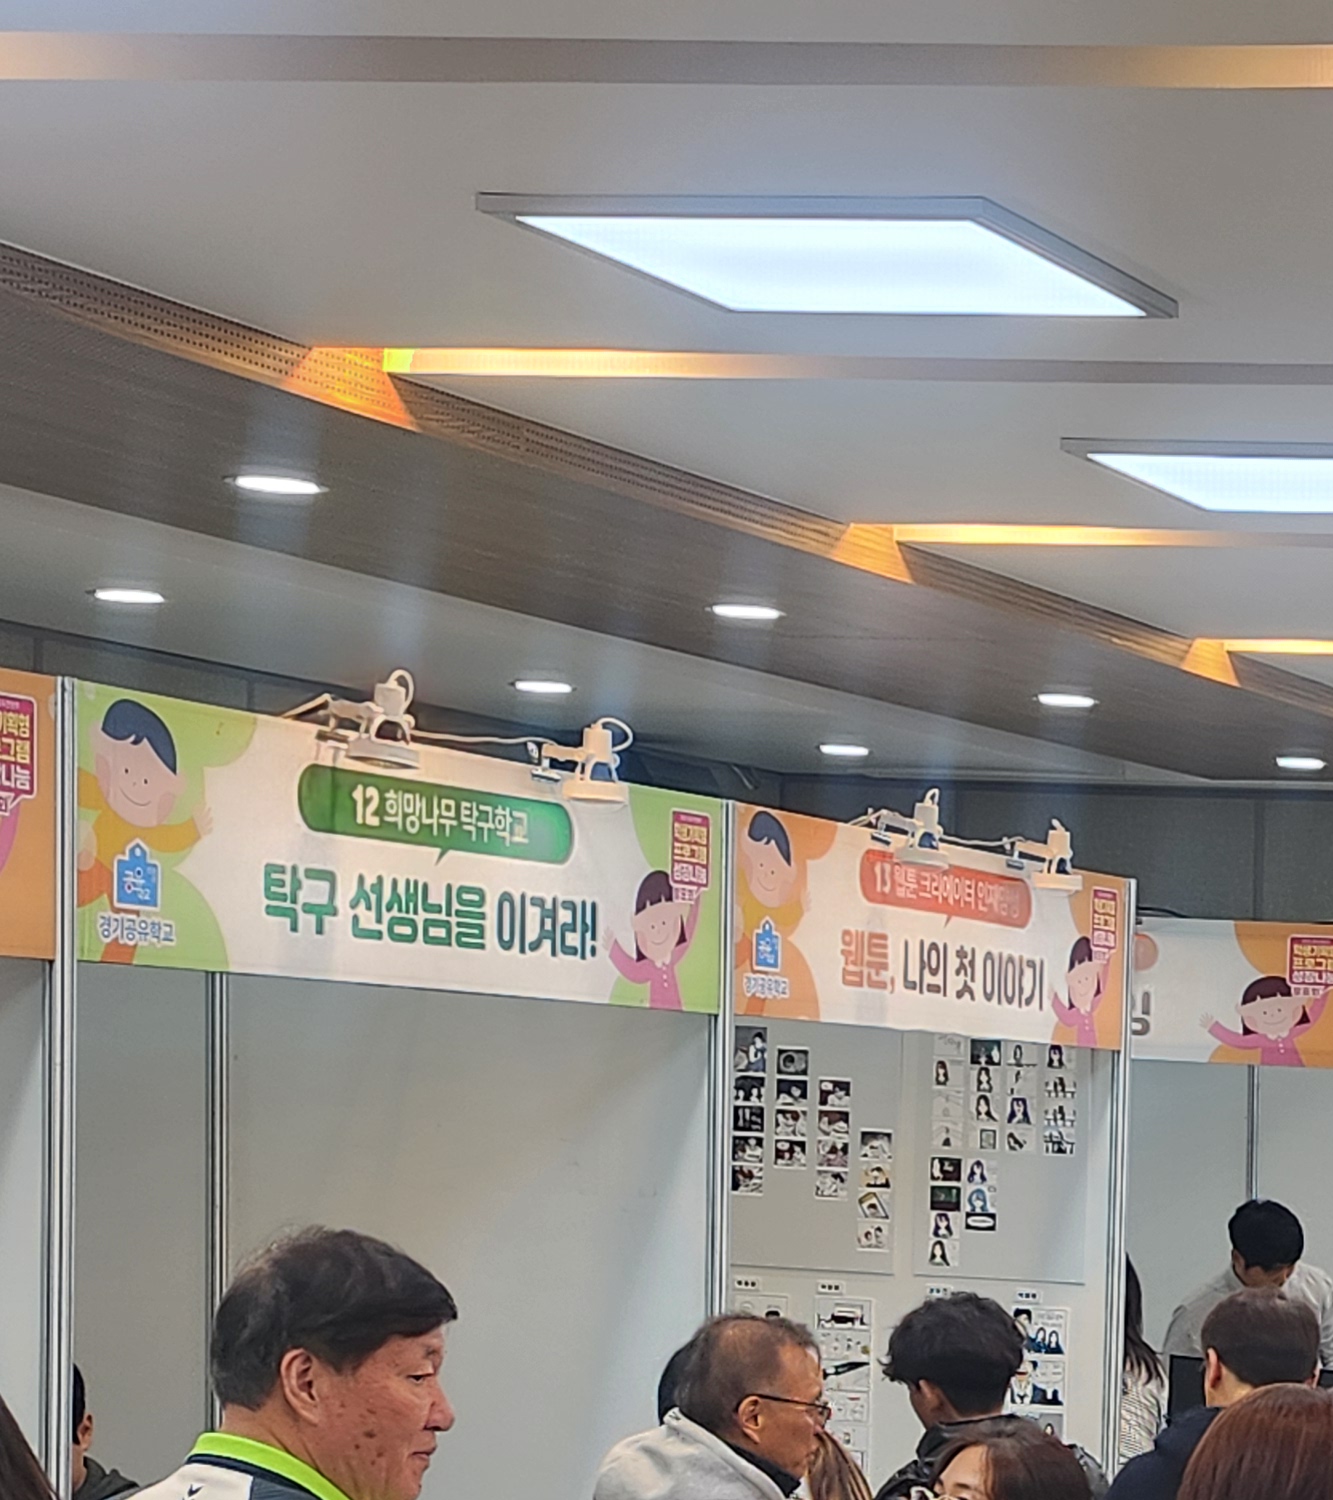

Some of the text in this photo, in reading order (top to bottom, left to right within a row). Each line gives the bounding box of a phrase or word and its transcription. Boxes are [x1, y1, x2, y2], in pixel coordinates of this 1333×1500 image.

[352, 783, 530, 847] 12 희망나무 탁구학교
[262, 862, 597, 961] 탁구 선생님을 이겨라!
[918, 870, 976, 910] 크리에이터
[99, 914, 175, 943] 경기공유학교
[840, 928, 1045, 1012] 웹툰, 나의 첫 이야기
